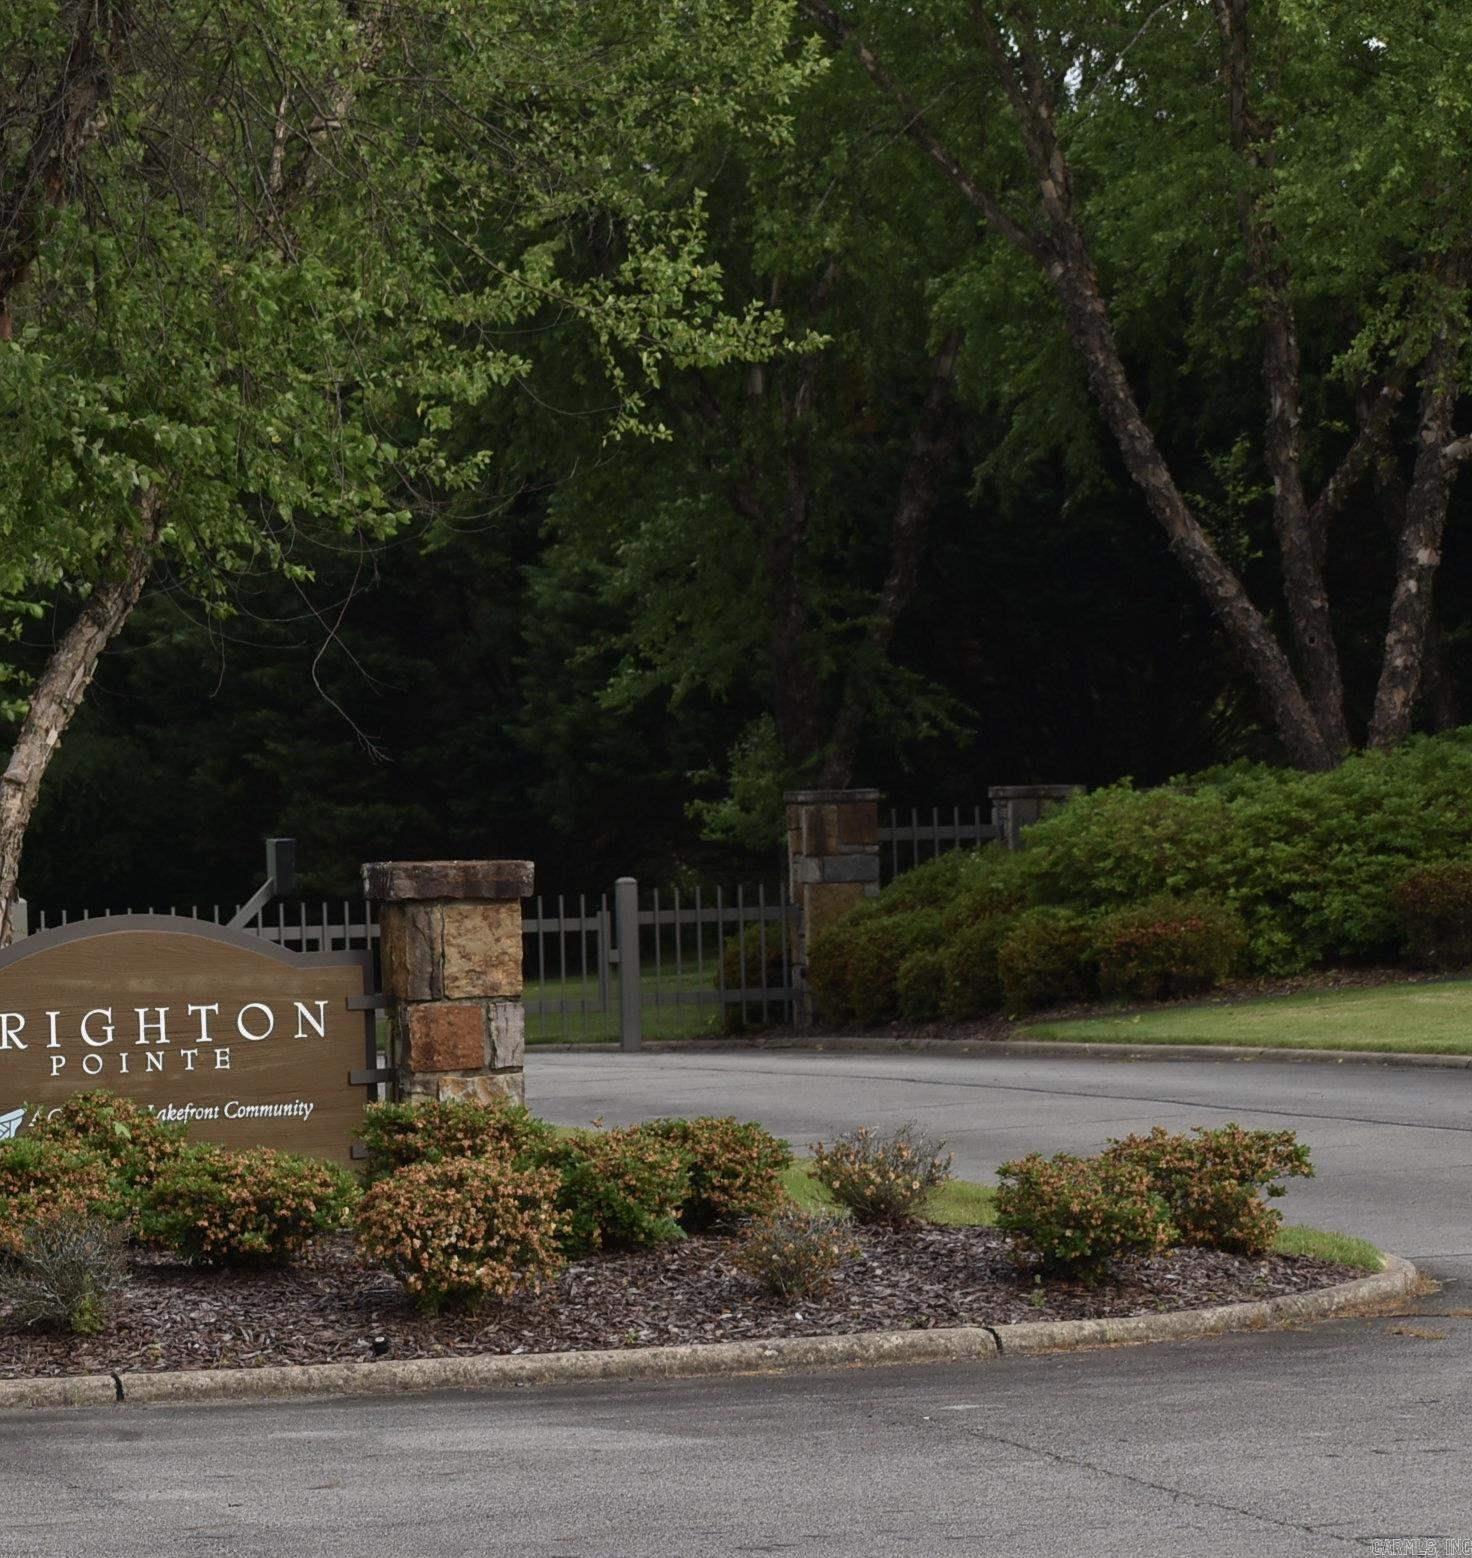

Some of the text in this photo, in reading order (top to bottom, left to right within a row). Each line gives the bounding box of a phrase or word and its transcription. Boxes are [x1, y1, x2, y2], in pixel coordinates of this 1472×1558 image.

[49, 1047, 231, 1077] POINTE
[148, 1099, 314, 1125] akefront Community
